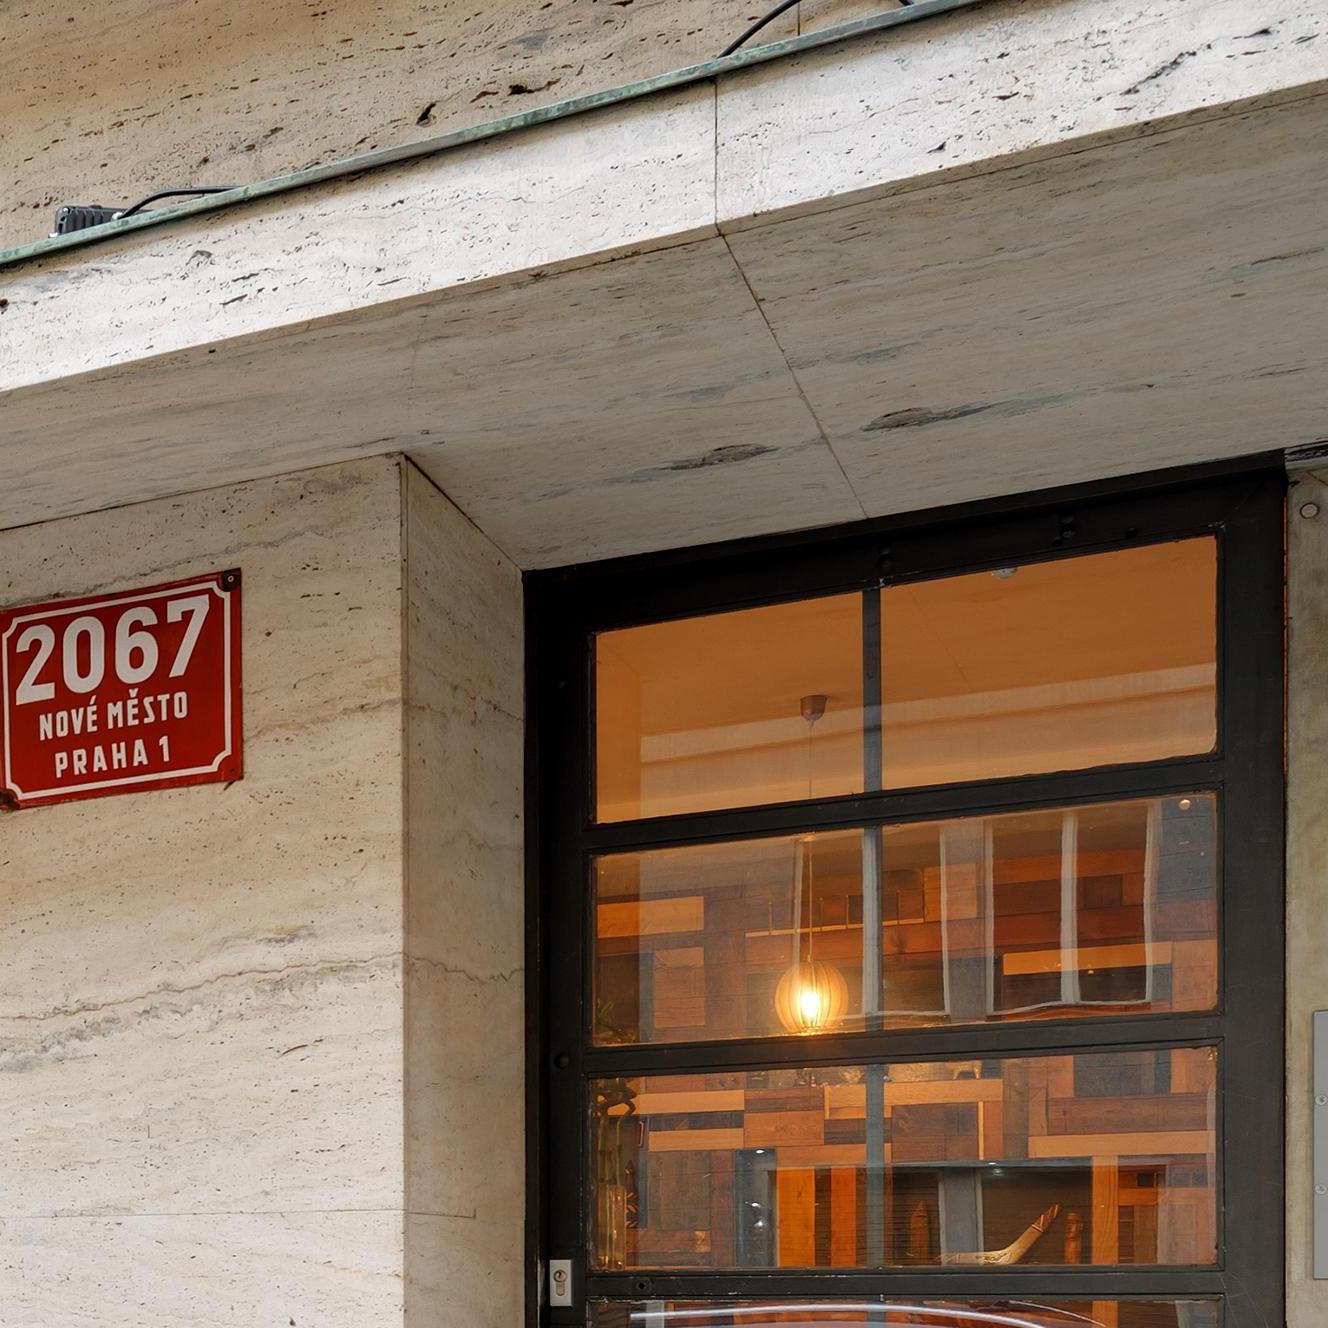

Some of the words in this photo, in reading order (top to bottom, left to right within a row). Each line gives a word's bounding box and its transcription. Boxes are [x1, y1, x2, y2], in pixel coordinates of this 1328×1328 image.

[15, 594, 210, 706] 2067
[39, 695, 98, 741] NOVÉ
[107, 688, 188, 730] MĚSTO
[54, 739, 149, 779] PRAHA
[158, 735, 171, 762] 1
